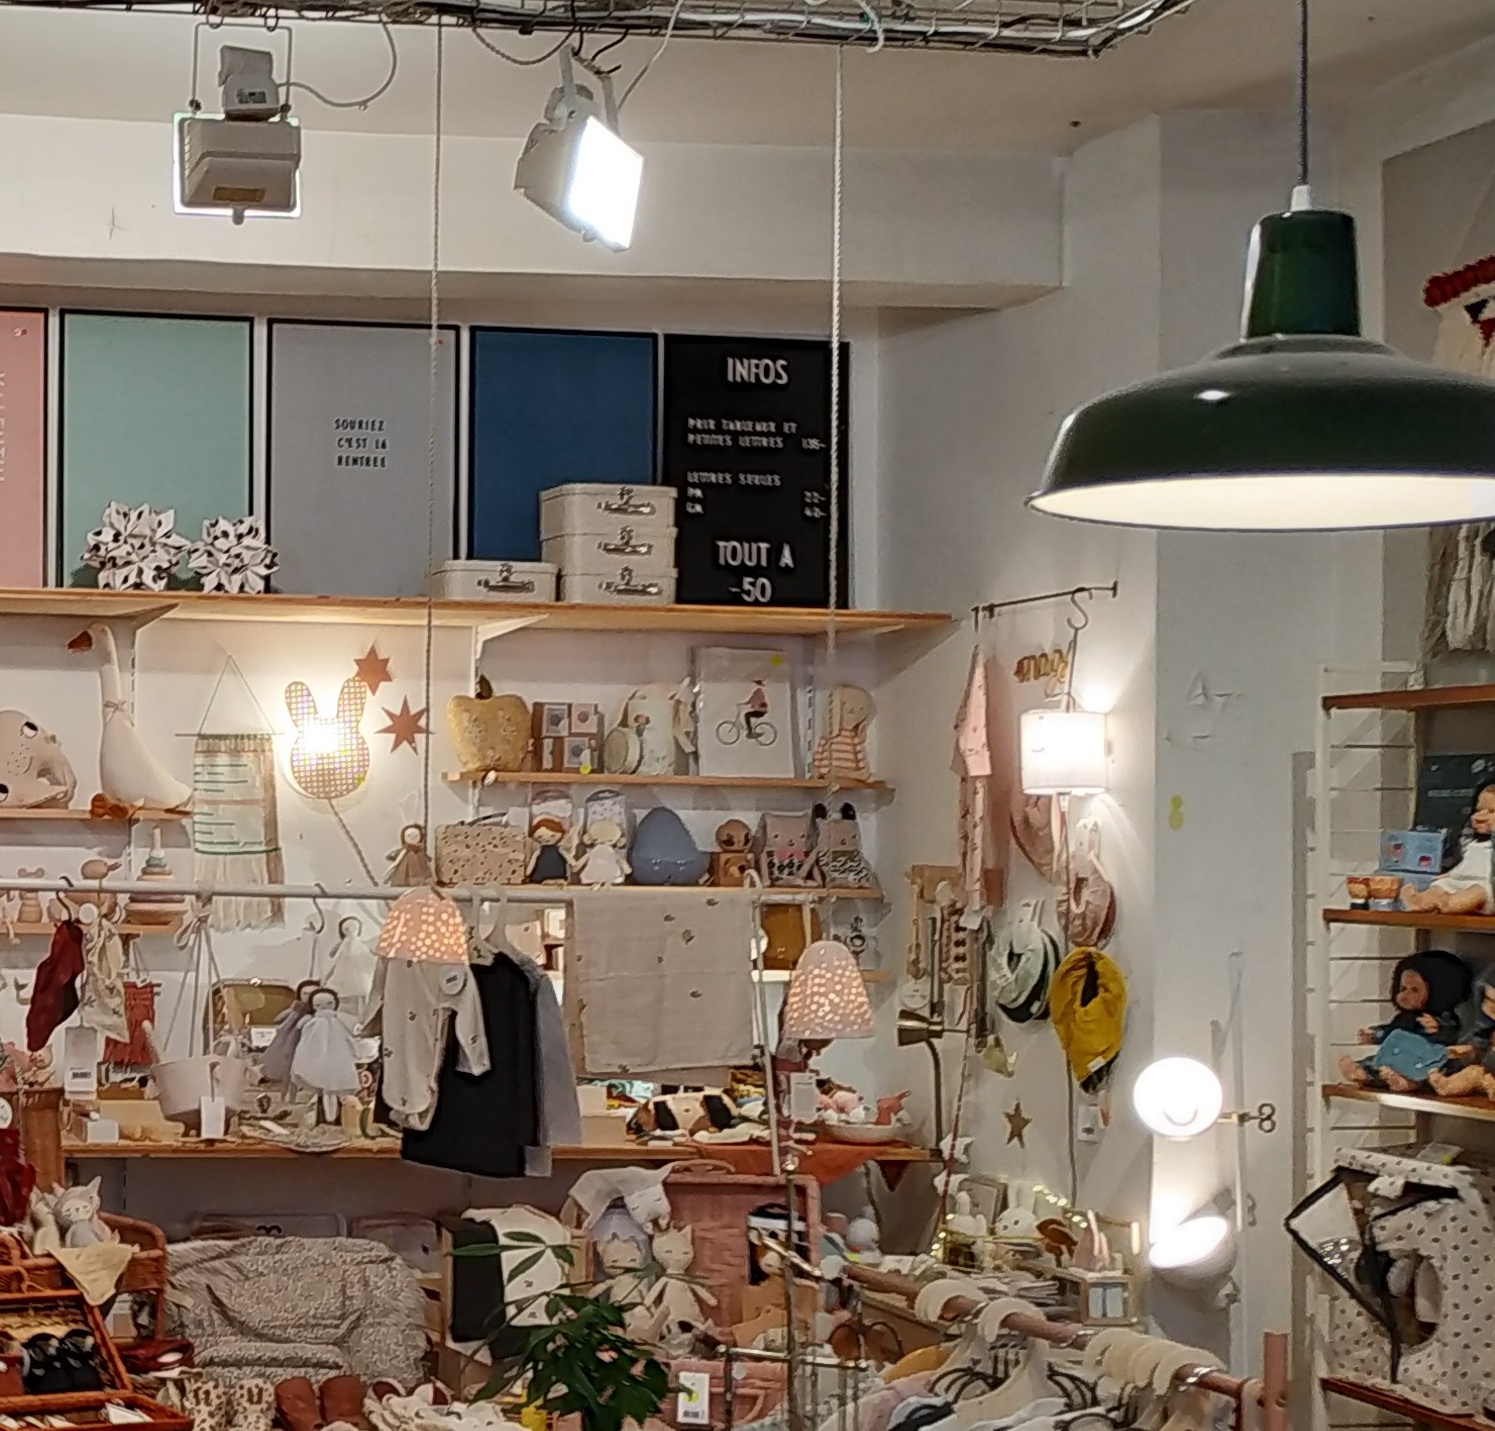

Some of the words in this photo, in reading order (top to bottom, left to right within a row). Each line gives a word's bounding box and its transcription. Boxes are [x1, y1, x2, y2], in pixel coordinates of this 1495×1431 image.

[727, 357, 789, 385] INFOS
[334, 418, 385, 432] SOURIEZ
[337, 437, 368, 450] C'EST
[375, 438, 387, 450] LA
[739, 435, 784, 448] LETTRES
[687, 471, 733, 485] LETTRES
[715, 540, 771, 568] TOUT
[778, 542, 795, 568] A
[728, 577, 773, 603] -50
